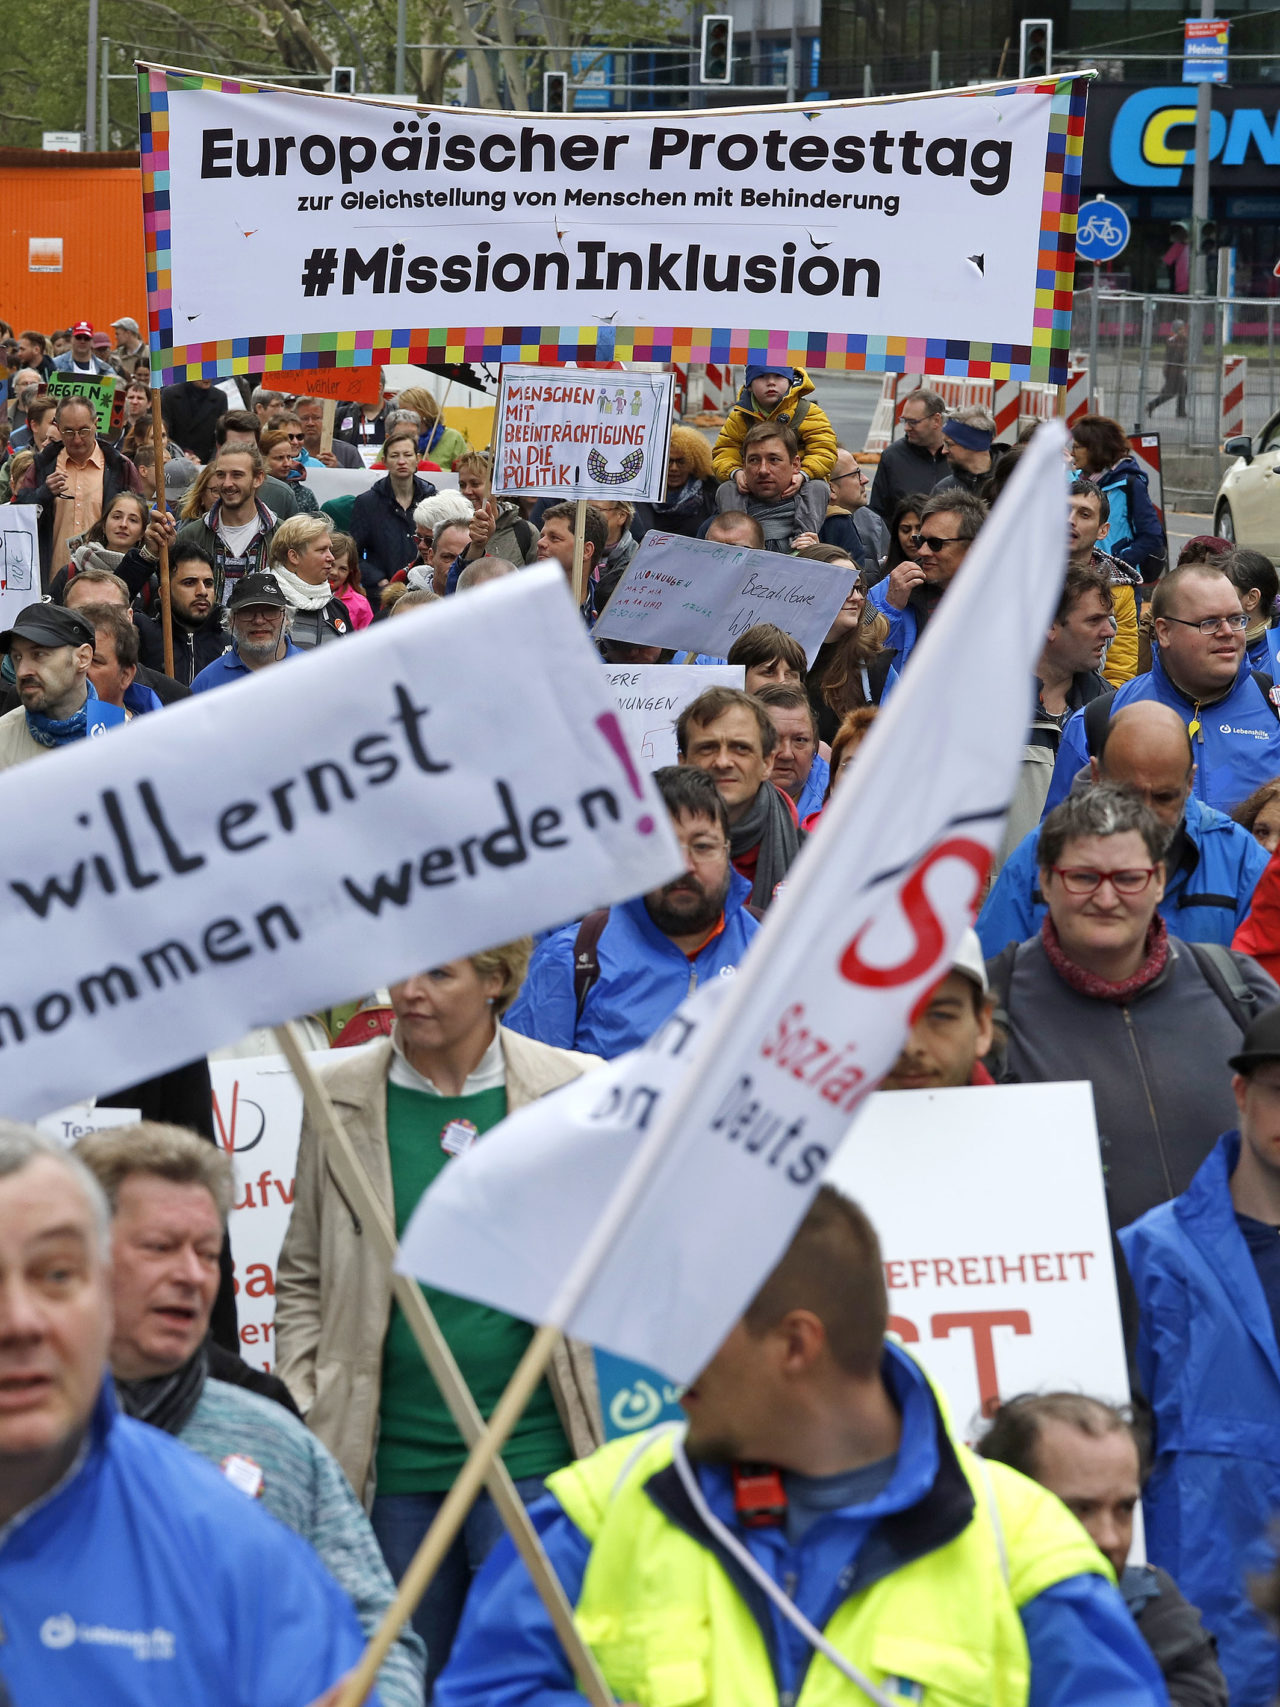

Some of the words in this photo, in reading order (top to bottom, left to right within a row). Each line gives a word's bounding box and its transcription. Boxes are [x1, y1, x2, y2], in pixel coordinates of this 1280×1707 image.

[201, 120, 629, 184] Europäischer
[649, 127, 1012, 196] Protesttag
[298, 192, 334, 211] zur
[341, 188, 506, 211] Gleichstellung
[514, 192, 557, 206] von
[564, 188, 686, 206] Menschen
[694, 187, 733, 207] mit
[741, 188, 900, 216] Behinderung
[301, 241, 880, 297] #MissionInklusion
[508, 386, 595, 405] MENSCHEN
[634, 570, 693, 589] WOHNUNGEN
[9, 778, 206, 919] will
[218, 682, 453, 854] ernst
[342, 712, 655, 918] werden!
